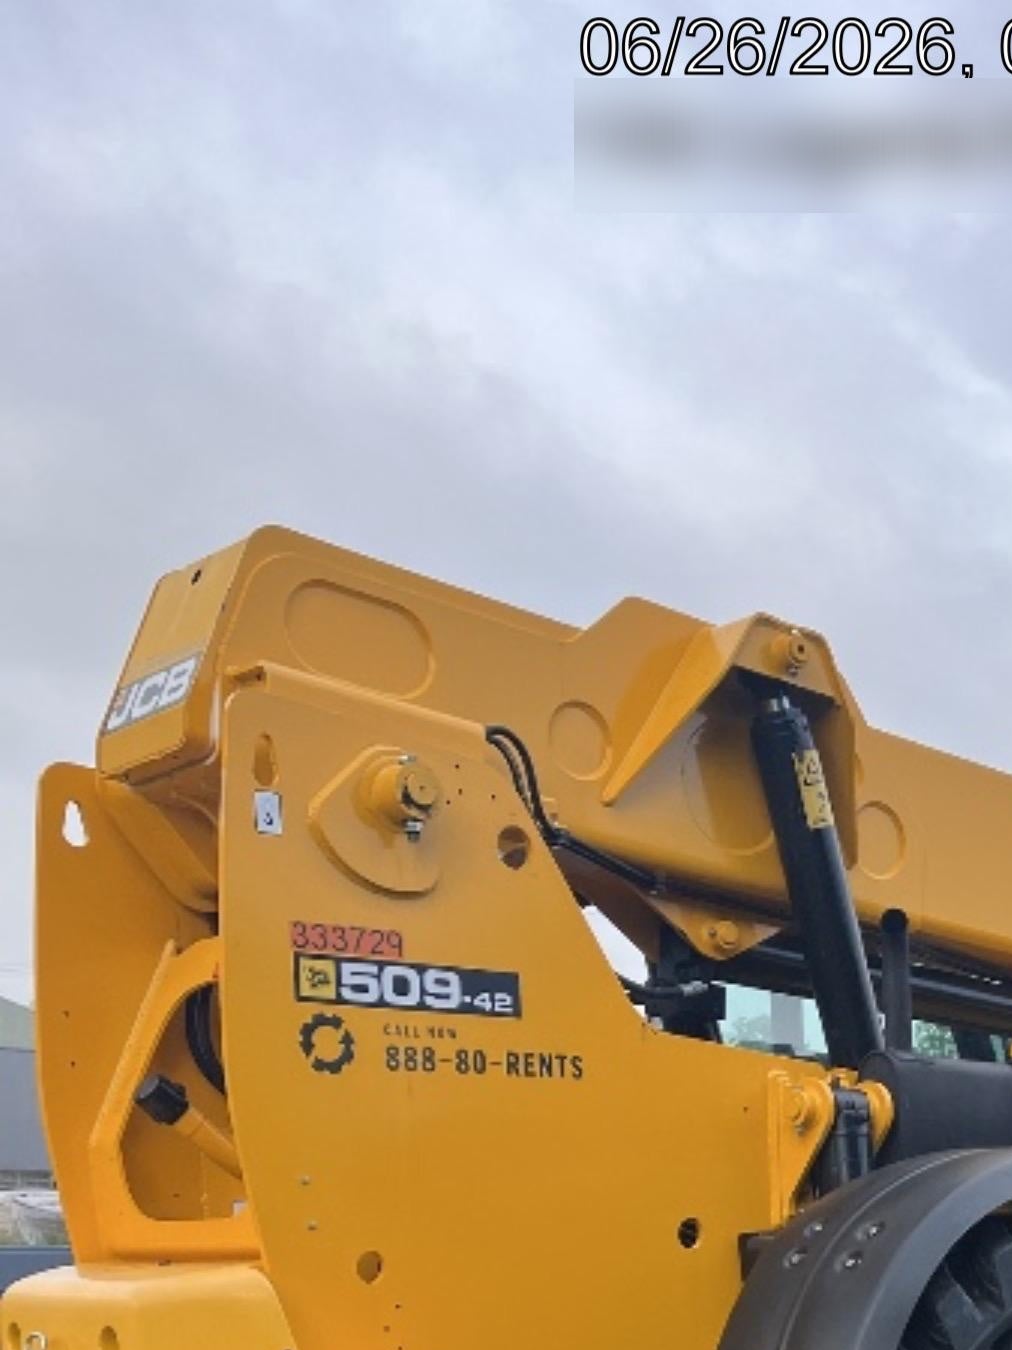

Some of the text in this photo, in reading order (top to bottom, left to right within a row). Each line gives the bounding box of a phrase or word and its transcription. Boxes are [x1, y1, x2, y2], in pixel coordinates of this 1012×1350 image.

[107, 657, 196, 731] JCB
[292, 921, 403, 957] 333729
[385, 1045, 584, 1080] 888-80-RENTS
